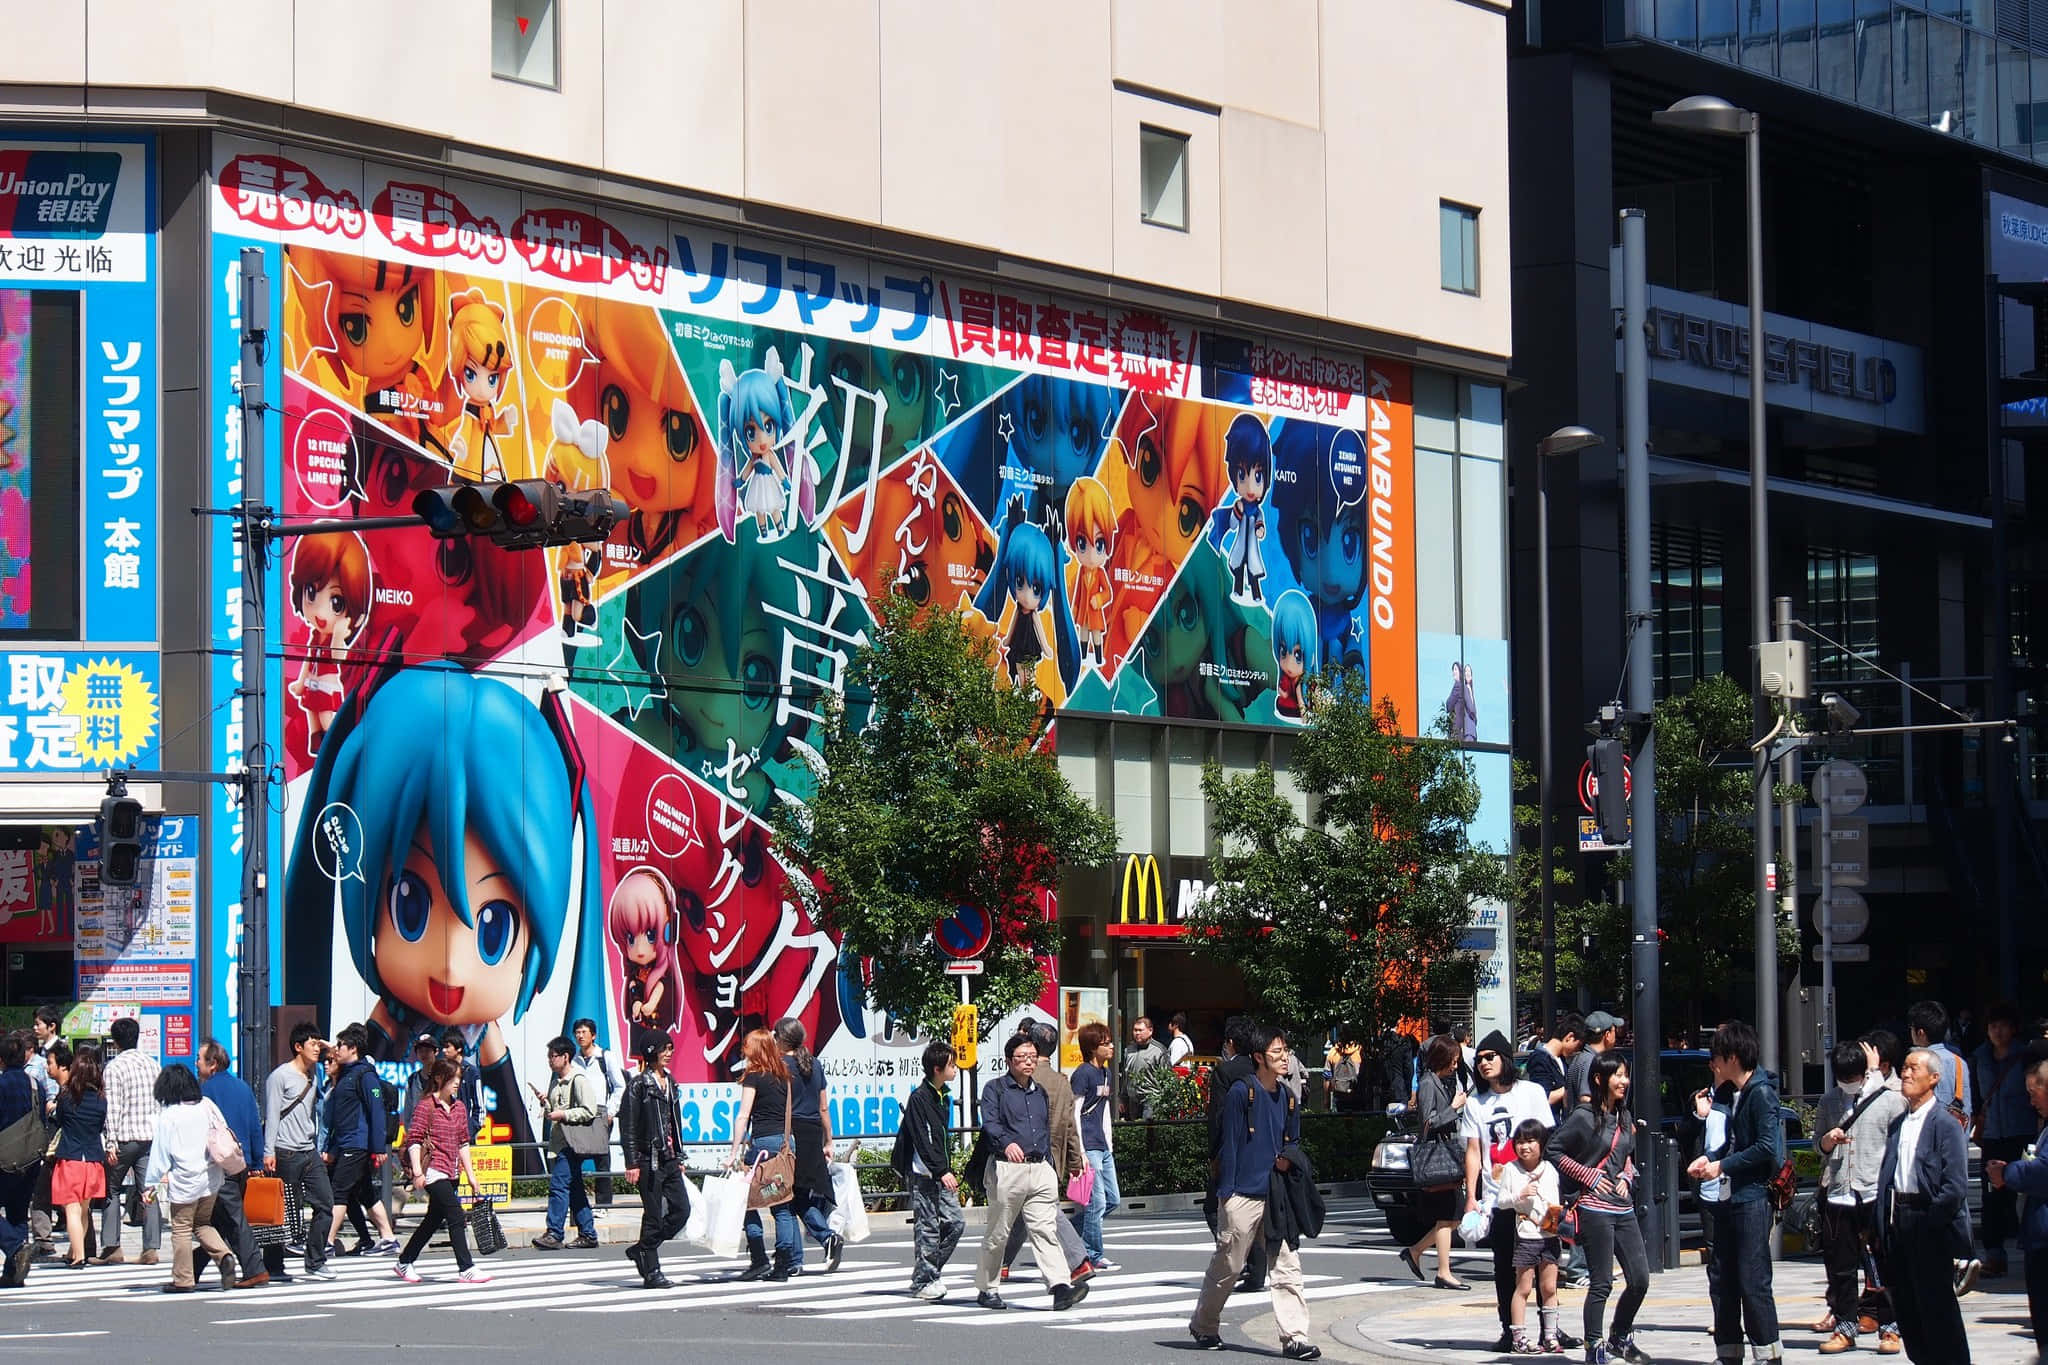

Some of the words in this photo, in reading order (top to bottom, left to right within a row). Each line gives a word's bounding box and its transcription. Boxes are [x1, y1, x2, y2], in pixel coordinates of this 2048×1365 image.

[0, 174, 111, 200] UnionPay
[37, 200, 100, 223] 银联
[238, 160, 363, 238] 売るのも
[386, 185, 505, 260] 買うのも
[522, 218, 667, 293] サポートも!
[674, 234, 935, 342] ソフマップ
[1251, 346, 1364, 391] ポイントに貯めると
[1251, 377, 1338, 416] さらにおトク!!
[101, 341, 143, 499] ソフマップ
[307, 438, 318, 451] 12
[318, 439, 347, 455] ITEMS
[308, 454, 347, 471] SPECIAL
[307, 471, 329, 485] LINE
[1273, 470, 1298, 484] KAITO
[1370, 368, 1394, 630] KANBUNDO
[104, 517, 141, 589] 本館
[376, 588, 414, 606] MEIKO
[9, 655, 66, 711] 取
[87, 673, 123, 750] 無料
[655, 798, 690, 827] ATSUMETE
[612, 838, 649, 854] 巡音ルカ
[140, 1027, 159, 1036] ービス
[822, 1056, 895, 1076] ねんどろいどぷち
[830, 1083, 895, 1095] ATSUNE
